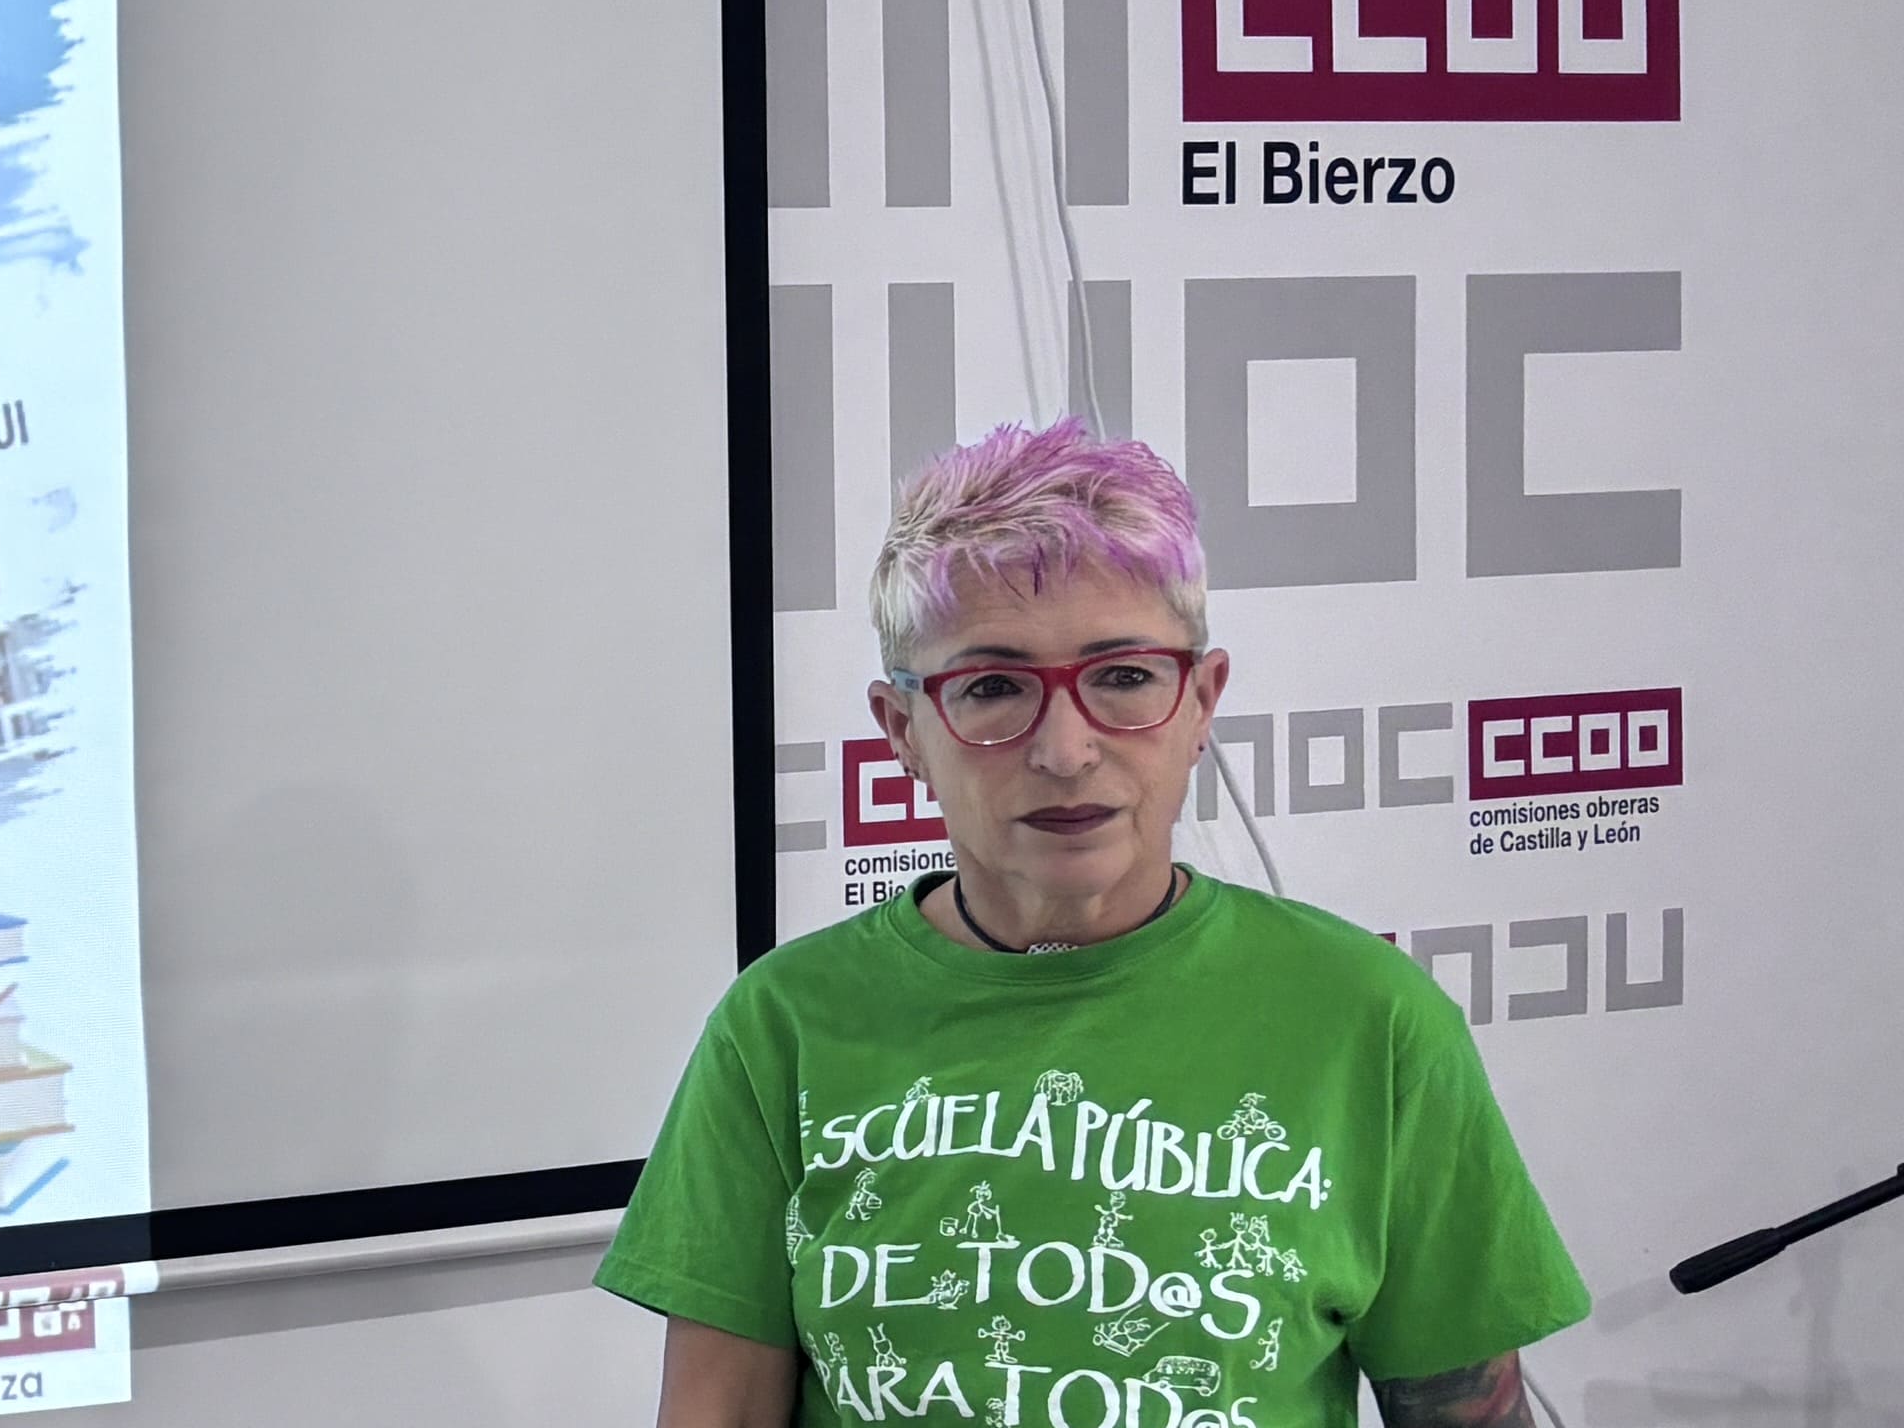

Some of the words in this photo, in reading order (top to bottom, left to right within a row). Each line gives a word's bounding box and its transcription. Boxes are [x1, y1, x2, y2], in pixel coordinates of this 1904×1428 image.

[1180, 140, 1238, 207] El
[1262, 140, 1456, 207] Bierzo
[1483, 709, 1669, 778] CCOO
[1469, 801, 1580, 827] comisiones
[1586, 796, 1660, 818] obreras
[844, 849, 956, 876] comisione
[1470, 833, 1493, 855] de
[1500, 827, 1572, 853] Castilla
[1577, 830, 1589, 851] y
[1594, 821, 1641, 845] León
[845, 882, 865, 906] El
[1070, 1097, 1333, 1210] PÚBLICA:
[819, 1242, 932, 1310] DE
[955, 1240, 1262, 1341] TOD@S
